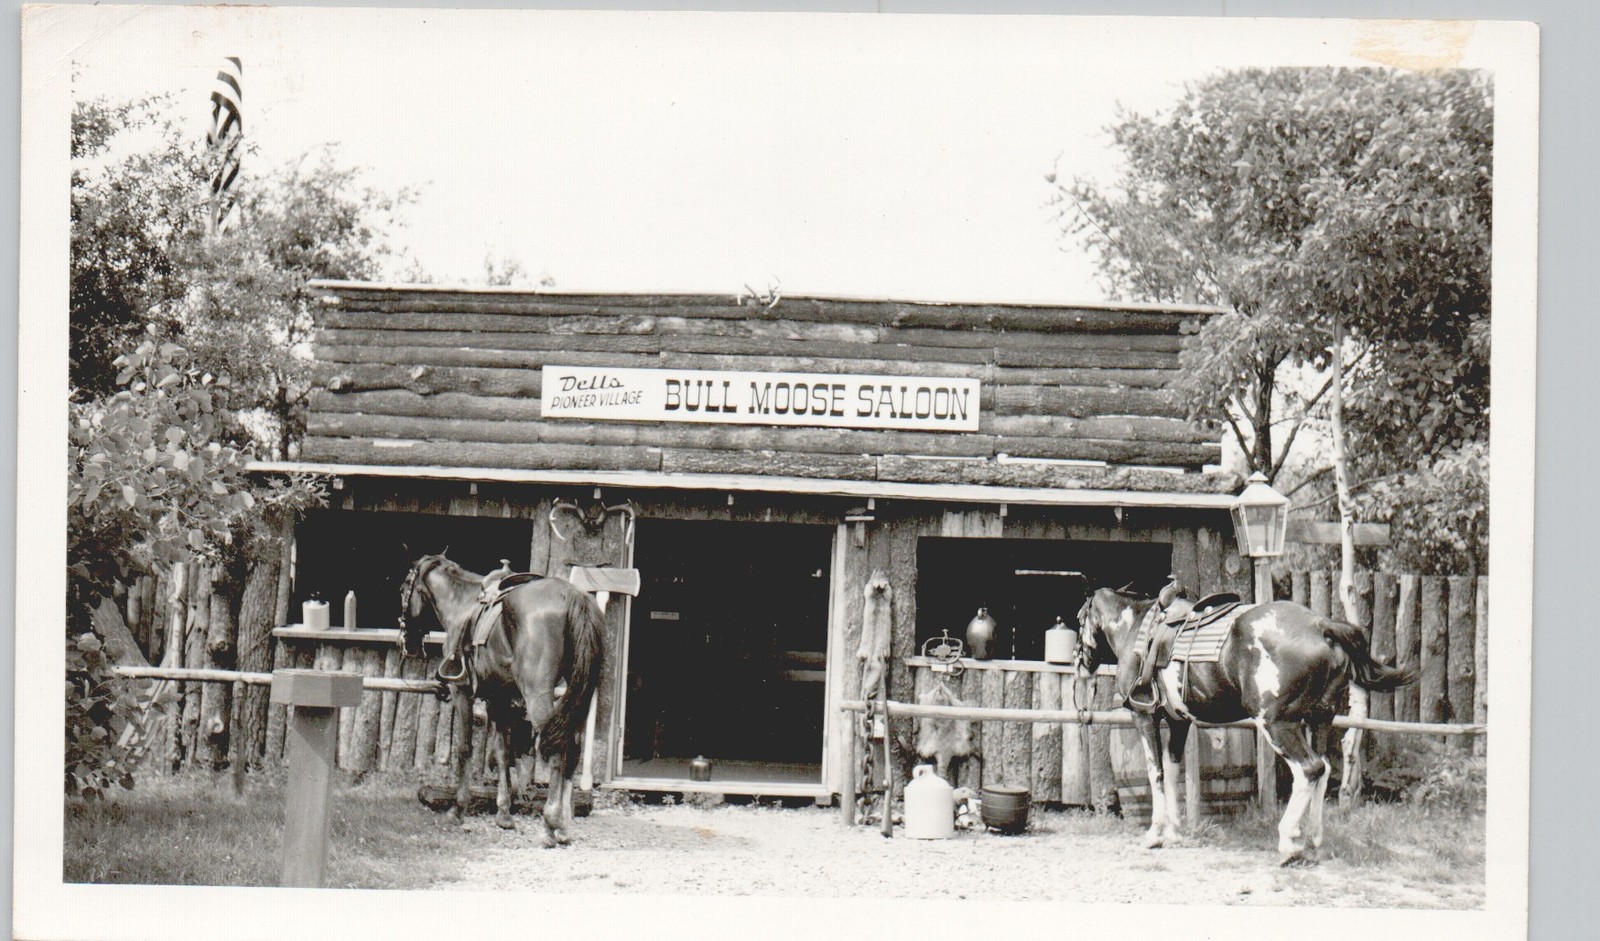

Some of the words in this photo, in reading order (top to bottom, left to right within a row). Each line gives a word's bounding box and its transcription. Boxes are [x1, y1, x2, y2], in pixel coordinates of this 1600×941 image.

[559, 375, 625, 392] Dells
[550, 393, 597, 410] PIONEER
[599, 390, 643, 407] VILLAGE
[664, 378, 738, 414] BULL
[748, 381, 846, 417] MOOSE
[856, 384, 970, 421] SALOON
